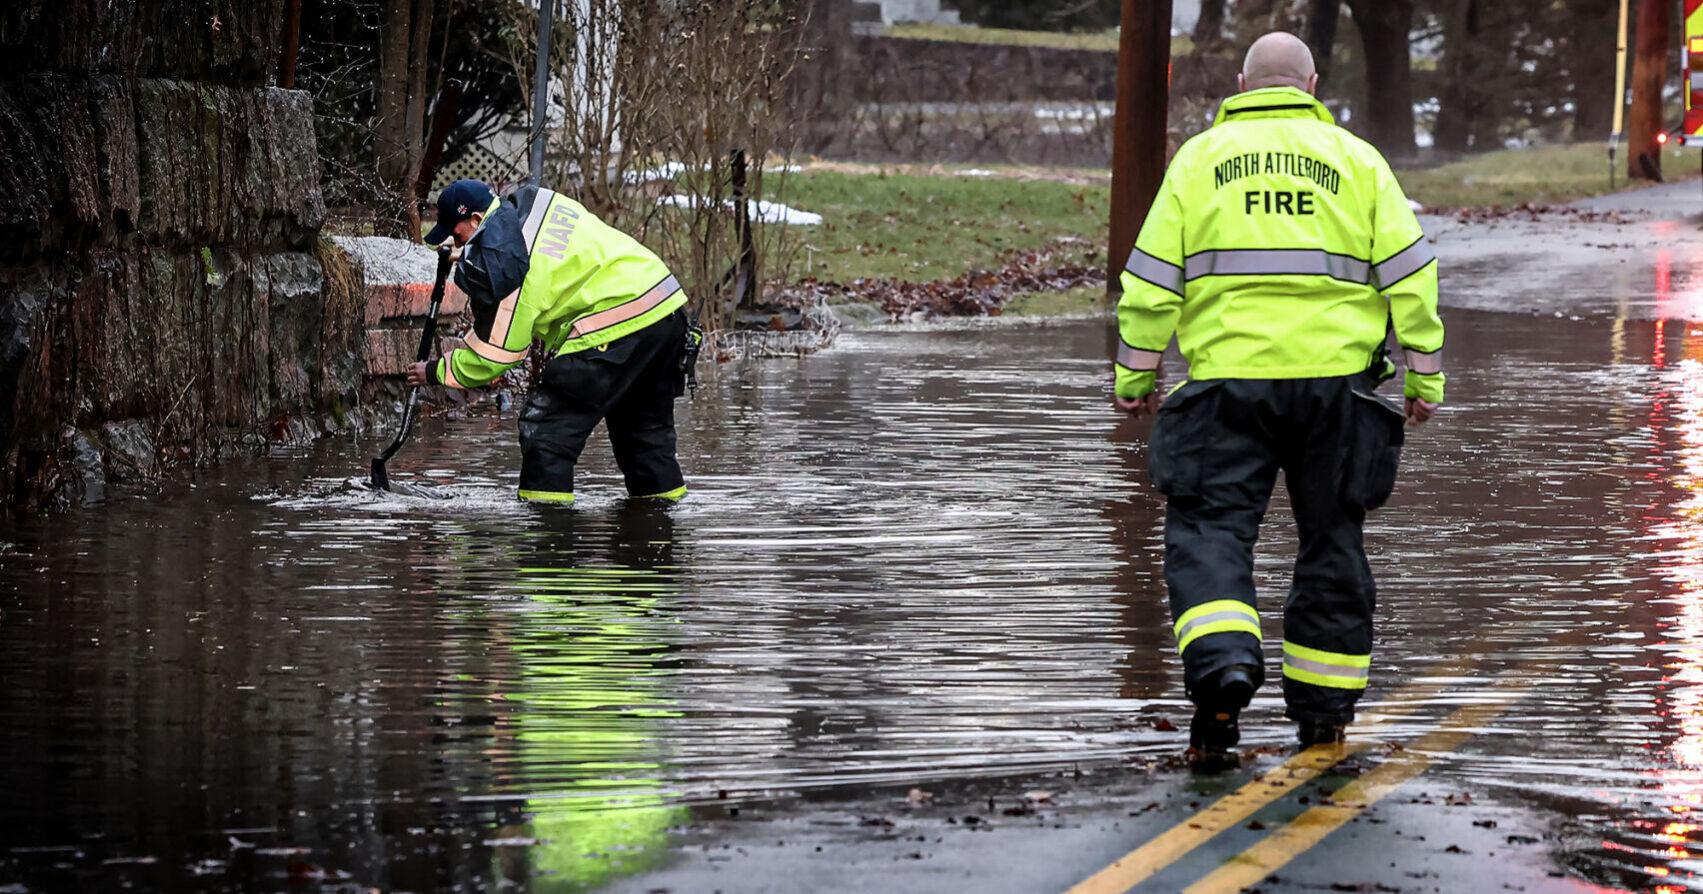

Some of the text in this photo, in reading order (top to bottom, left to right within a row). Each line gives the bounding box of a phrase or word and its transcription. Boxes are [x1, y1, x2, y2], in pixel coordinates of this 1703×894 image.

[1214, 152, 1340, 195] NORTH ATTLEBORO
[1245, 191, 1315, 215] FIRE
[538, 204, 579, 260] NAFD
